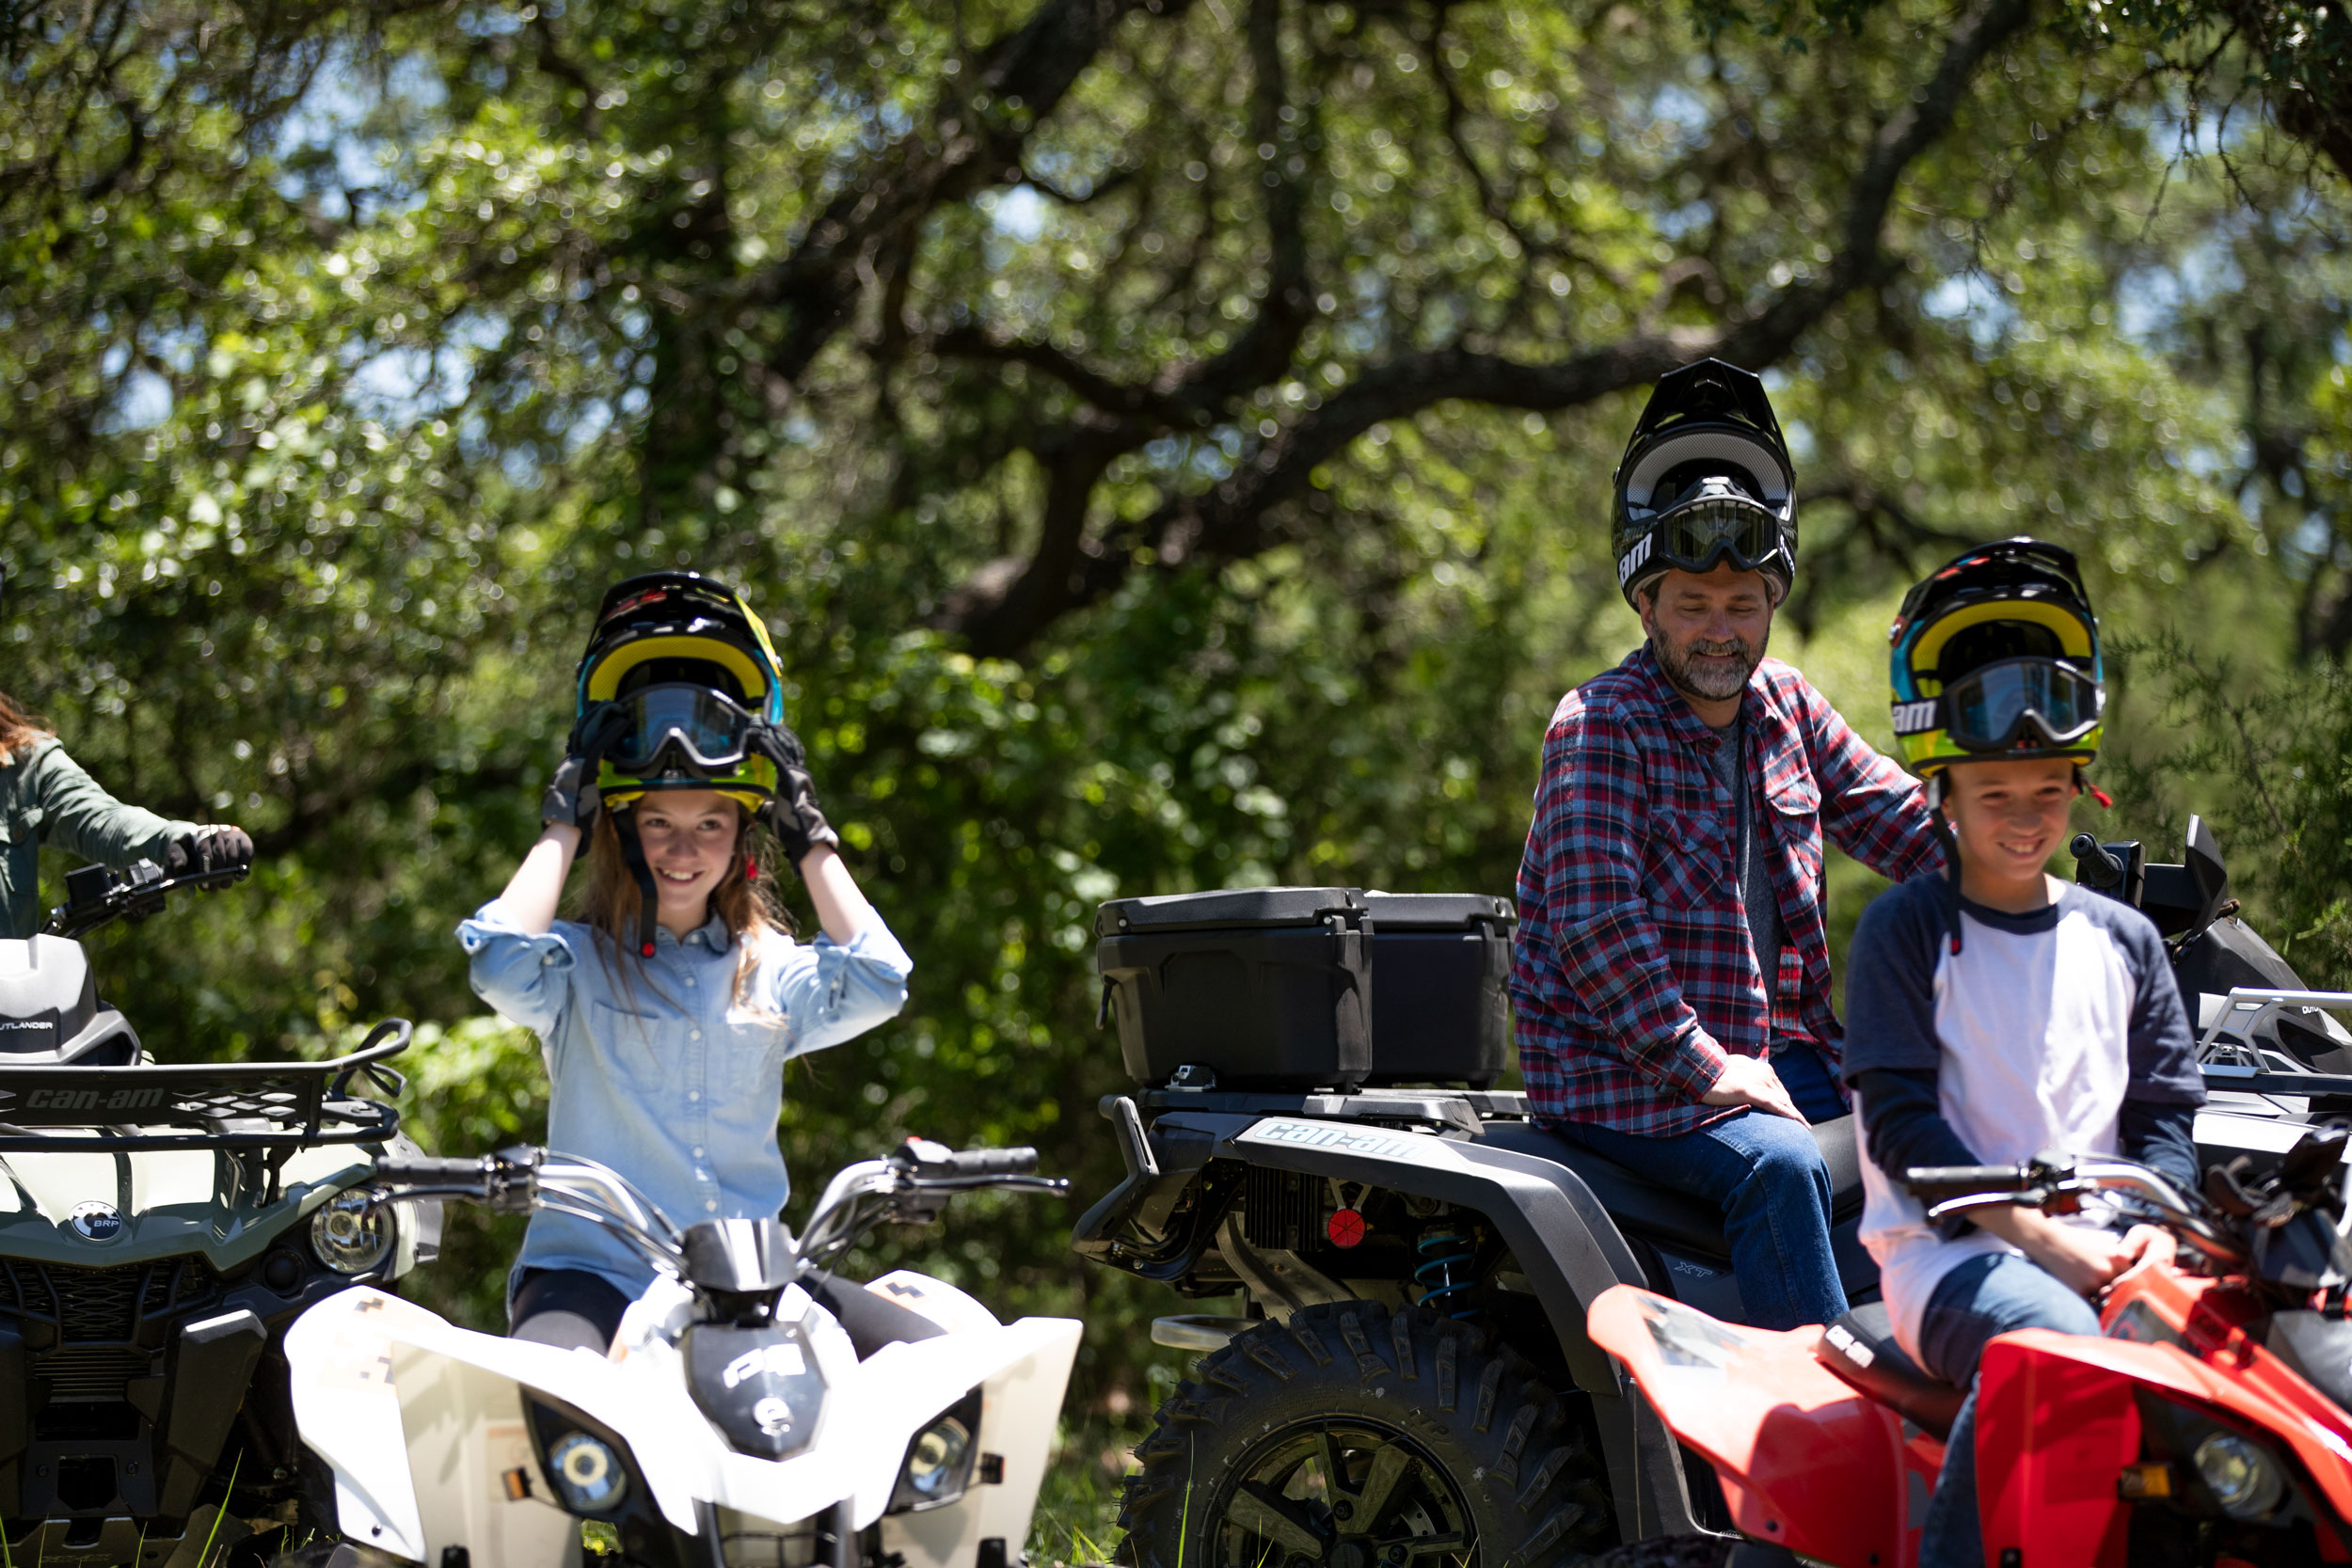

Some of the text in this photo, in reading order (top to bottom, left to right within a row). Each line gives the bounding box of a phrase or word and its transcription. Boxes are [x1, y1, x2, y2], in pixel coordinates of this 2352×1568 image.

[1619, 532, 1652, 589] am
[26, 1087, 164, 1110] can-am
[1254, 1121, 1425, 1159] can-am
[1674, 1261, 1713, 1277] XT
